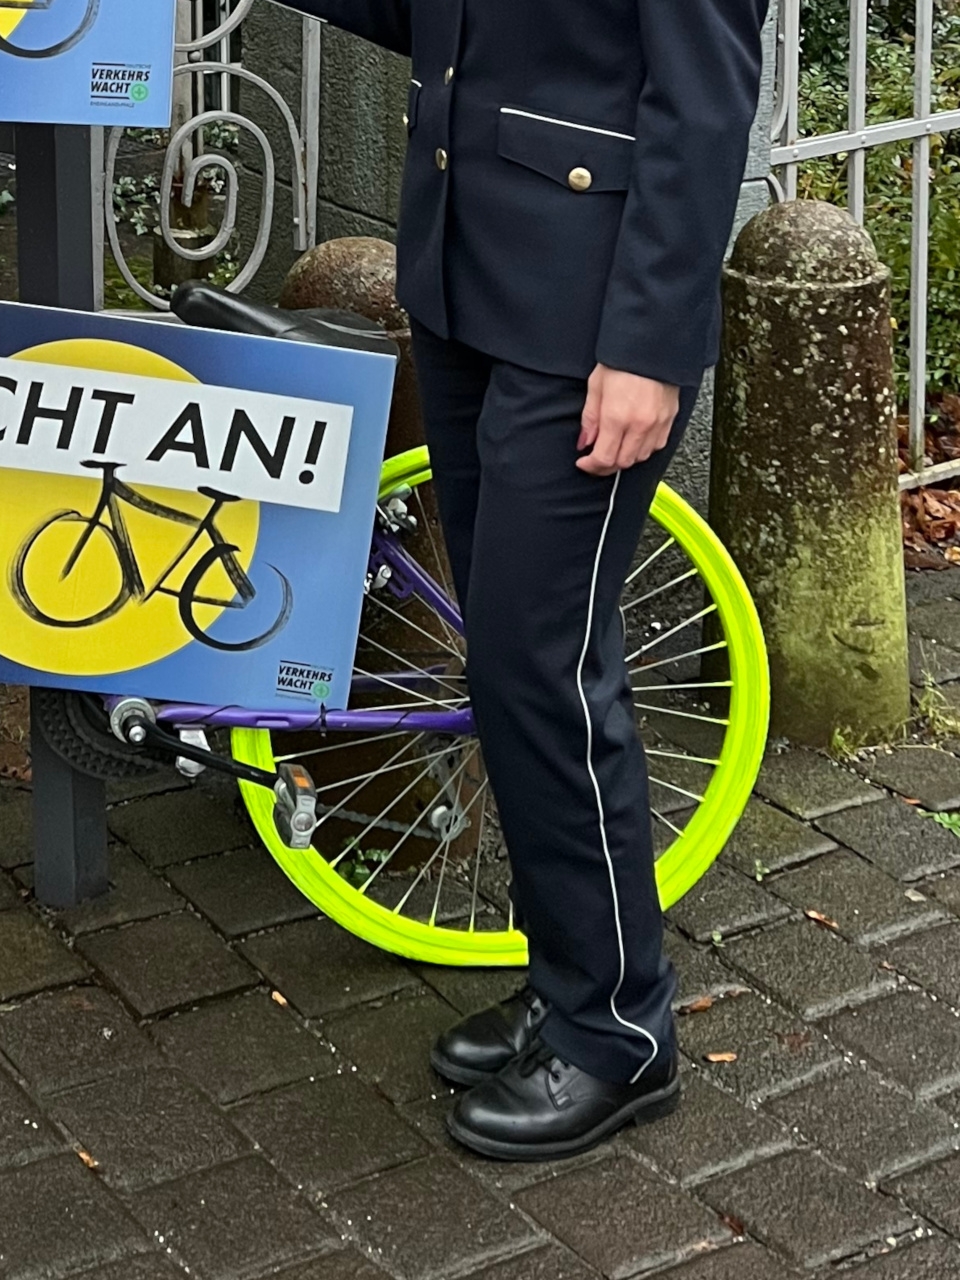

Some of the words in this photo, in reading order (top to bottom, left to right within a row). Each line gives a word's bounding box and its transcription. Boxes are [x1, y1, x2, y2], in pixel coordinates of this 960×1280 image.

[91, 68, 150, 81] VERKEHRS
[91, 81, 131, 93] WACHT
[147, 402, 327, 485] AN!
[279, 665, 332, 682] VERKEHRS
[277, 676, 314, 690] WACHT
